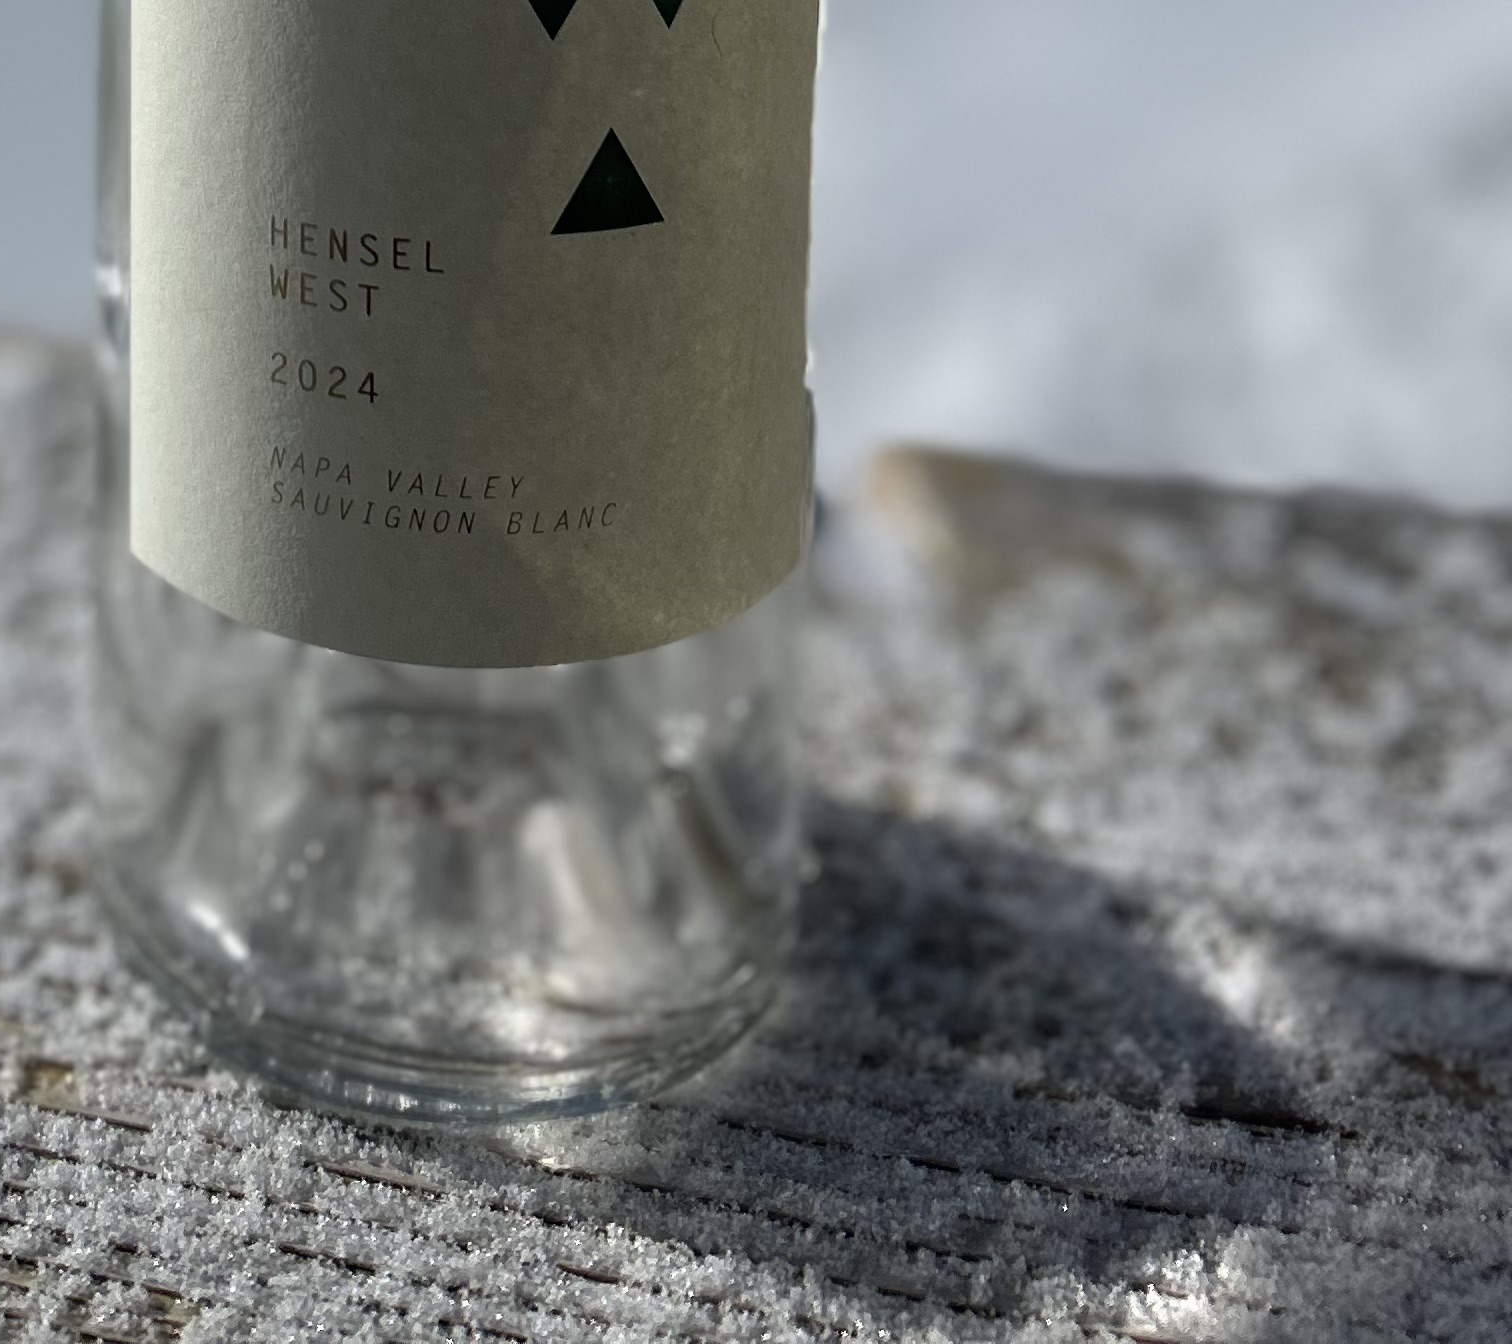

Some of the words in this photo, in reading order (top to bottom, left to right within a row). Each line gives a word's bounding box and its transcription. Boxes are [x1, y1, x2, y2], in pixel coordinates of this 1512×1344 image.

[270, 213, 445, 275] HENSEL
[269, 263, 380, 317] WEST
[270, 351, 379, 405] 2024
[270, 444, 353, 486] NAPA
[386, 469, 524, 500] VALLEY
[271, 480, 476, 535] SAUVIGNON
[505, 502, 618, 535] BLANC
